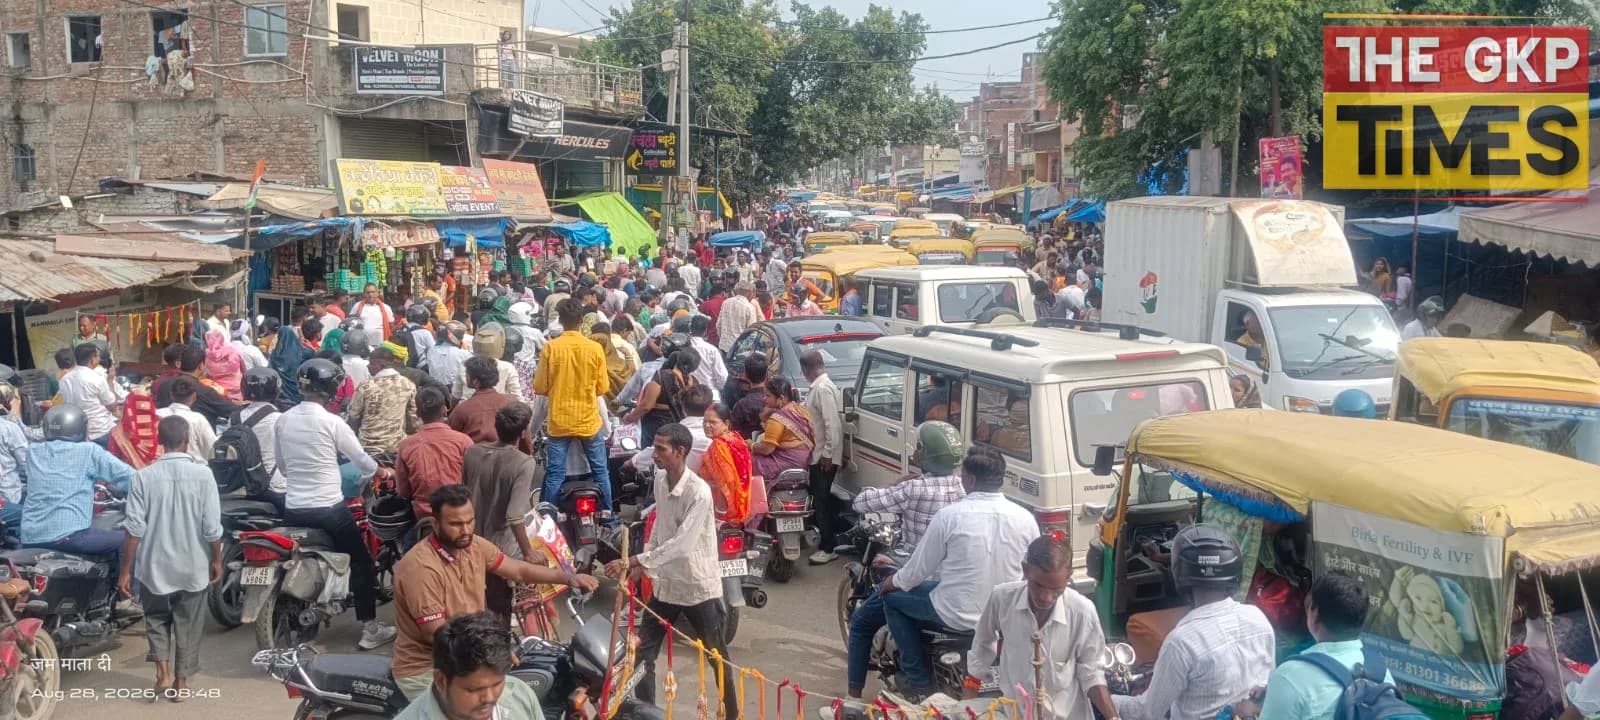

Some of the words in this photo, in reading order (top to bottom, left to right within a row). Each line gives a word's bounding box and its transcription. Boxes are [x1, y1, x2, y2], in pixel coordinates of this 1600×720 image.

[362, 50, 399, 62] VELVET
[403, 50, 439, 63] MOON
[553, 134, 611, 149] HERCULES
[470, 202, 496, 212] EVENT
[1351, 526, 1378, 544] Birla
[1383, 534, 1430, 559] Fertility
[1432, 546, 1443, 560] &
[1447, 549, 1474, 563] IVF
[423, 613, 442, 622] POLO
[1405, 661, 1440, 682] 81301
